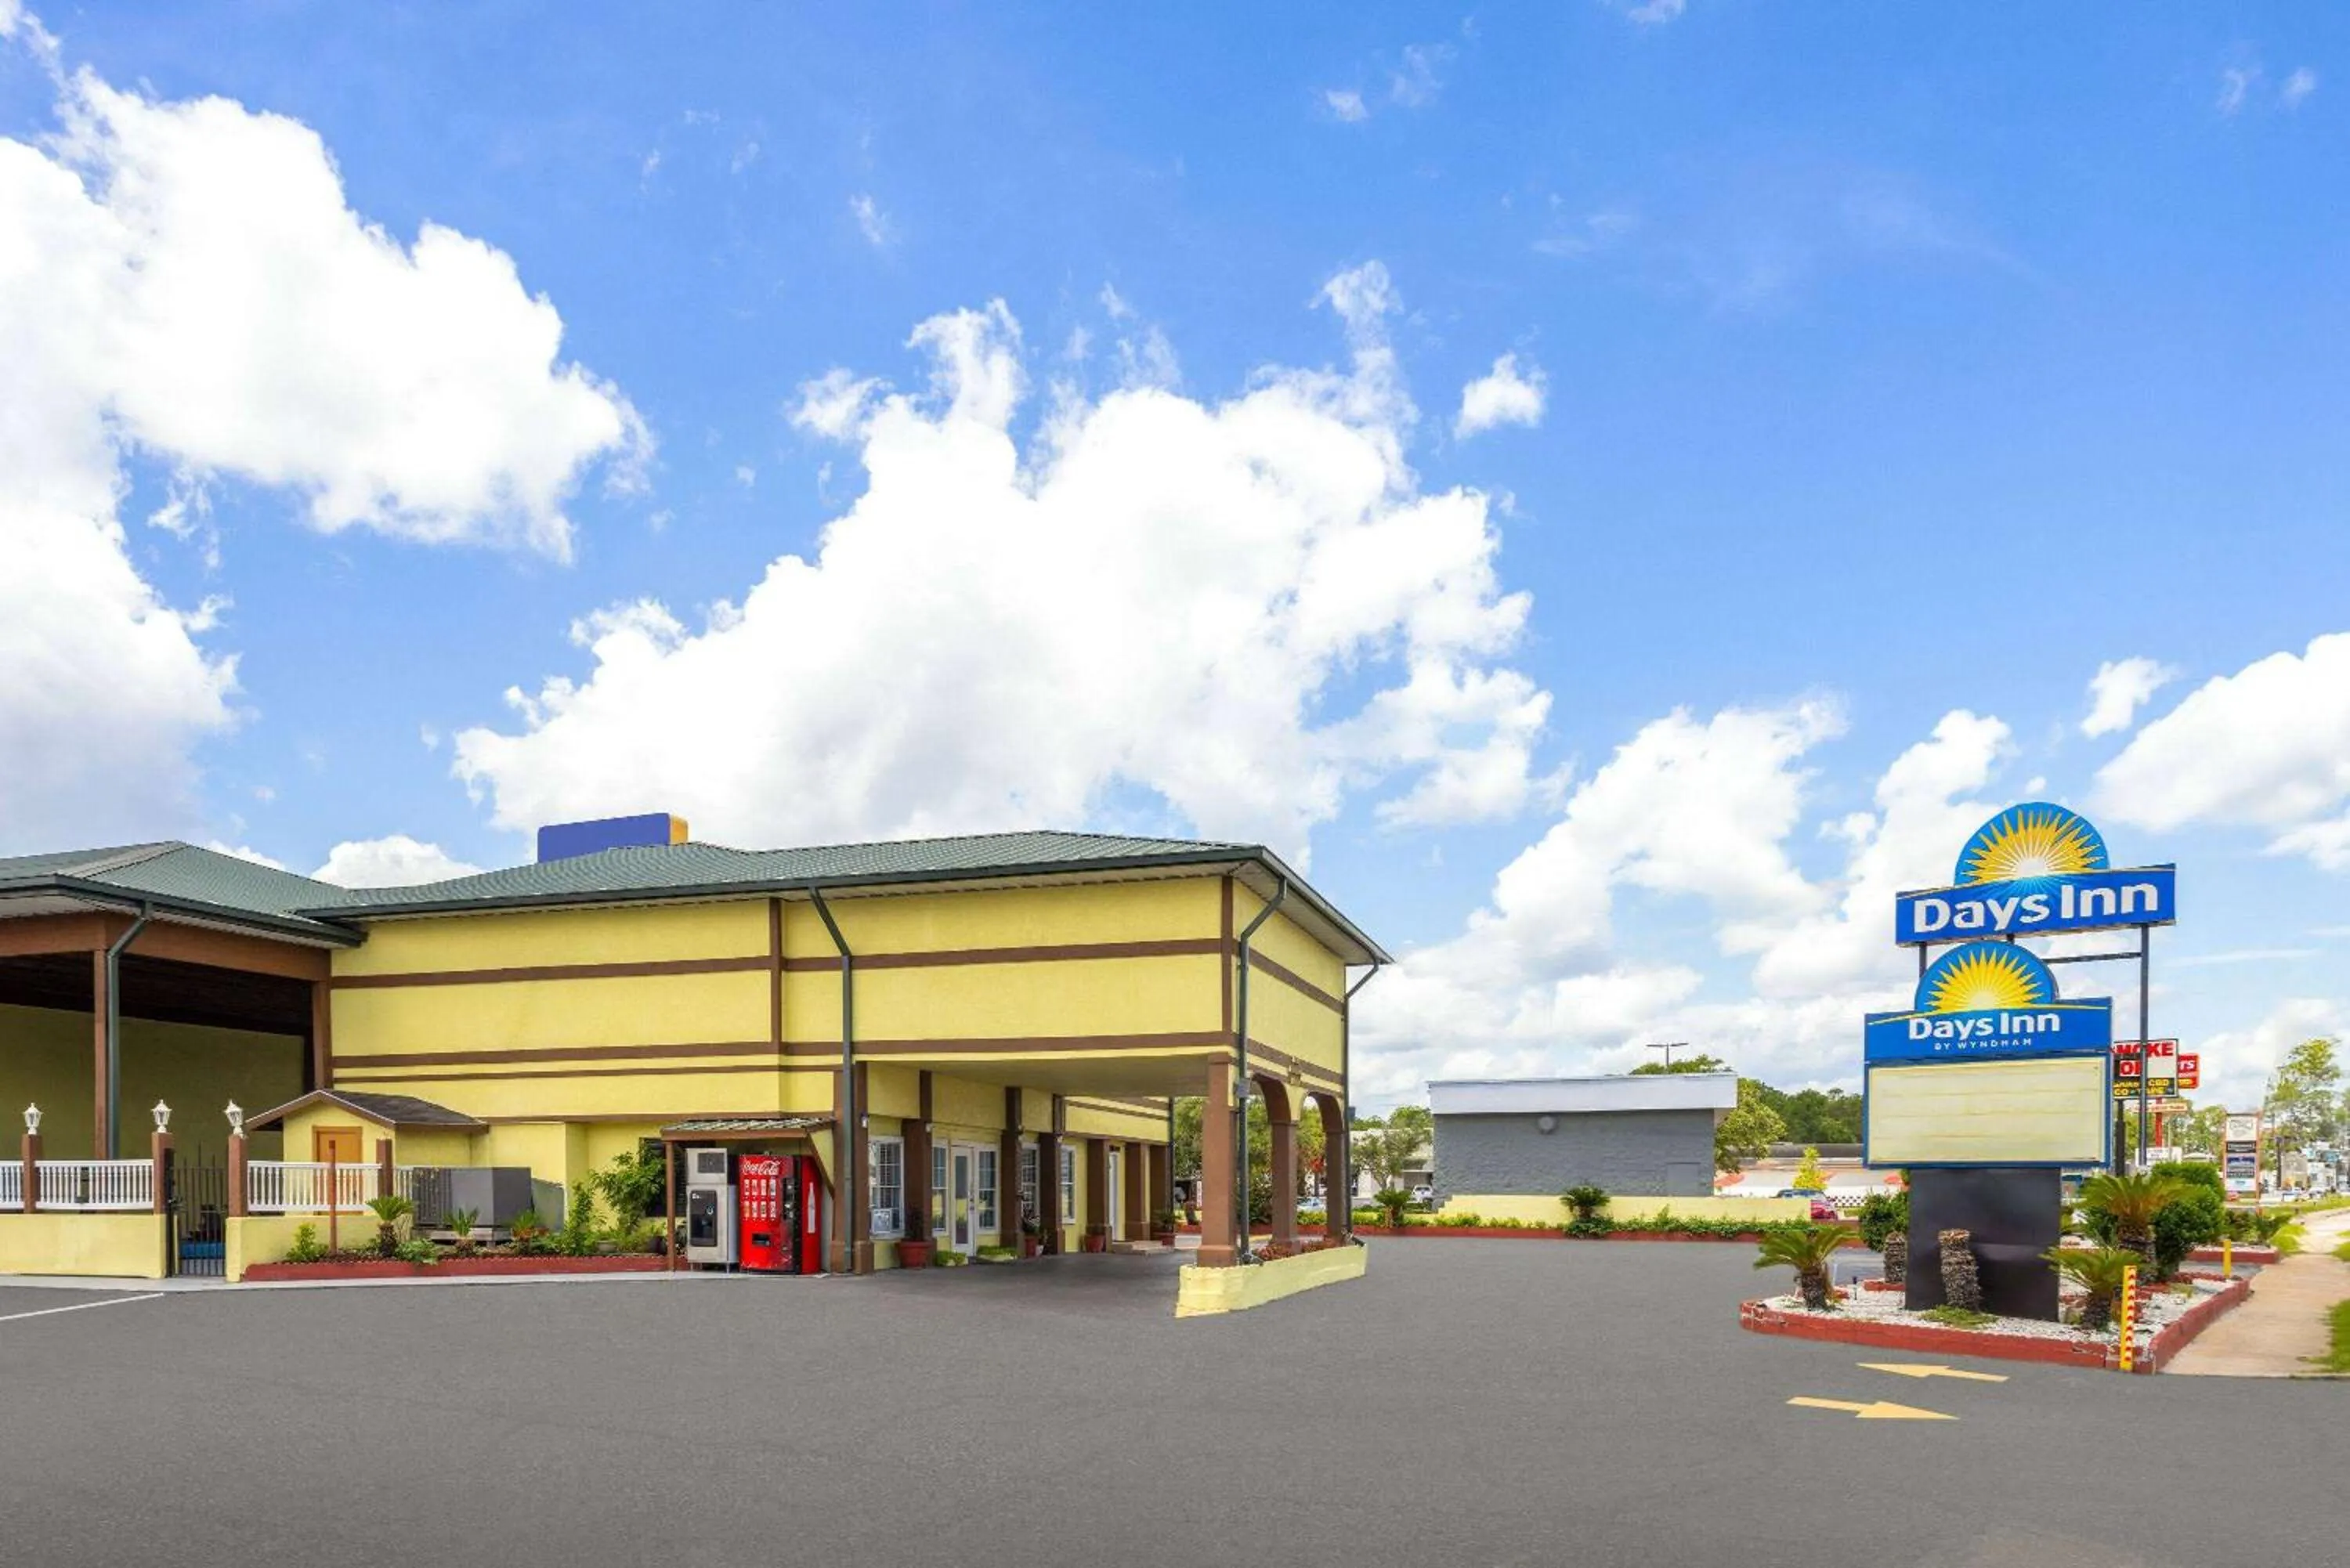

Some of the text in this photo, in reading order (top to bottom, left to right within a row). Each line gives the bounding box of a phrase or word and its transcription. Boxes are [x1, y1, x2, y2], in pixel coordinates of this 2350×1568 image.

[1914, 883, 2159, 933] Days Inn
[1909, 1012, 2061, 1040] Days Inn
[1934, 1038, 2033, 1050] BY WYNDHAM
[2110, 1042, 2175, 1057] MKE
